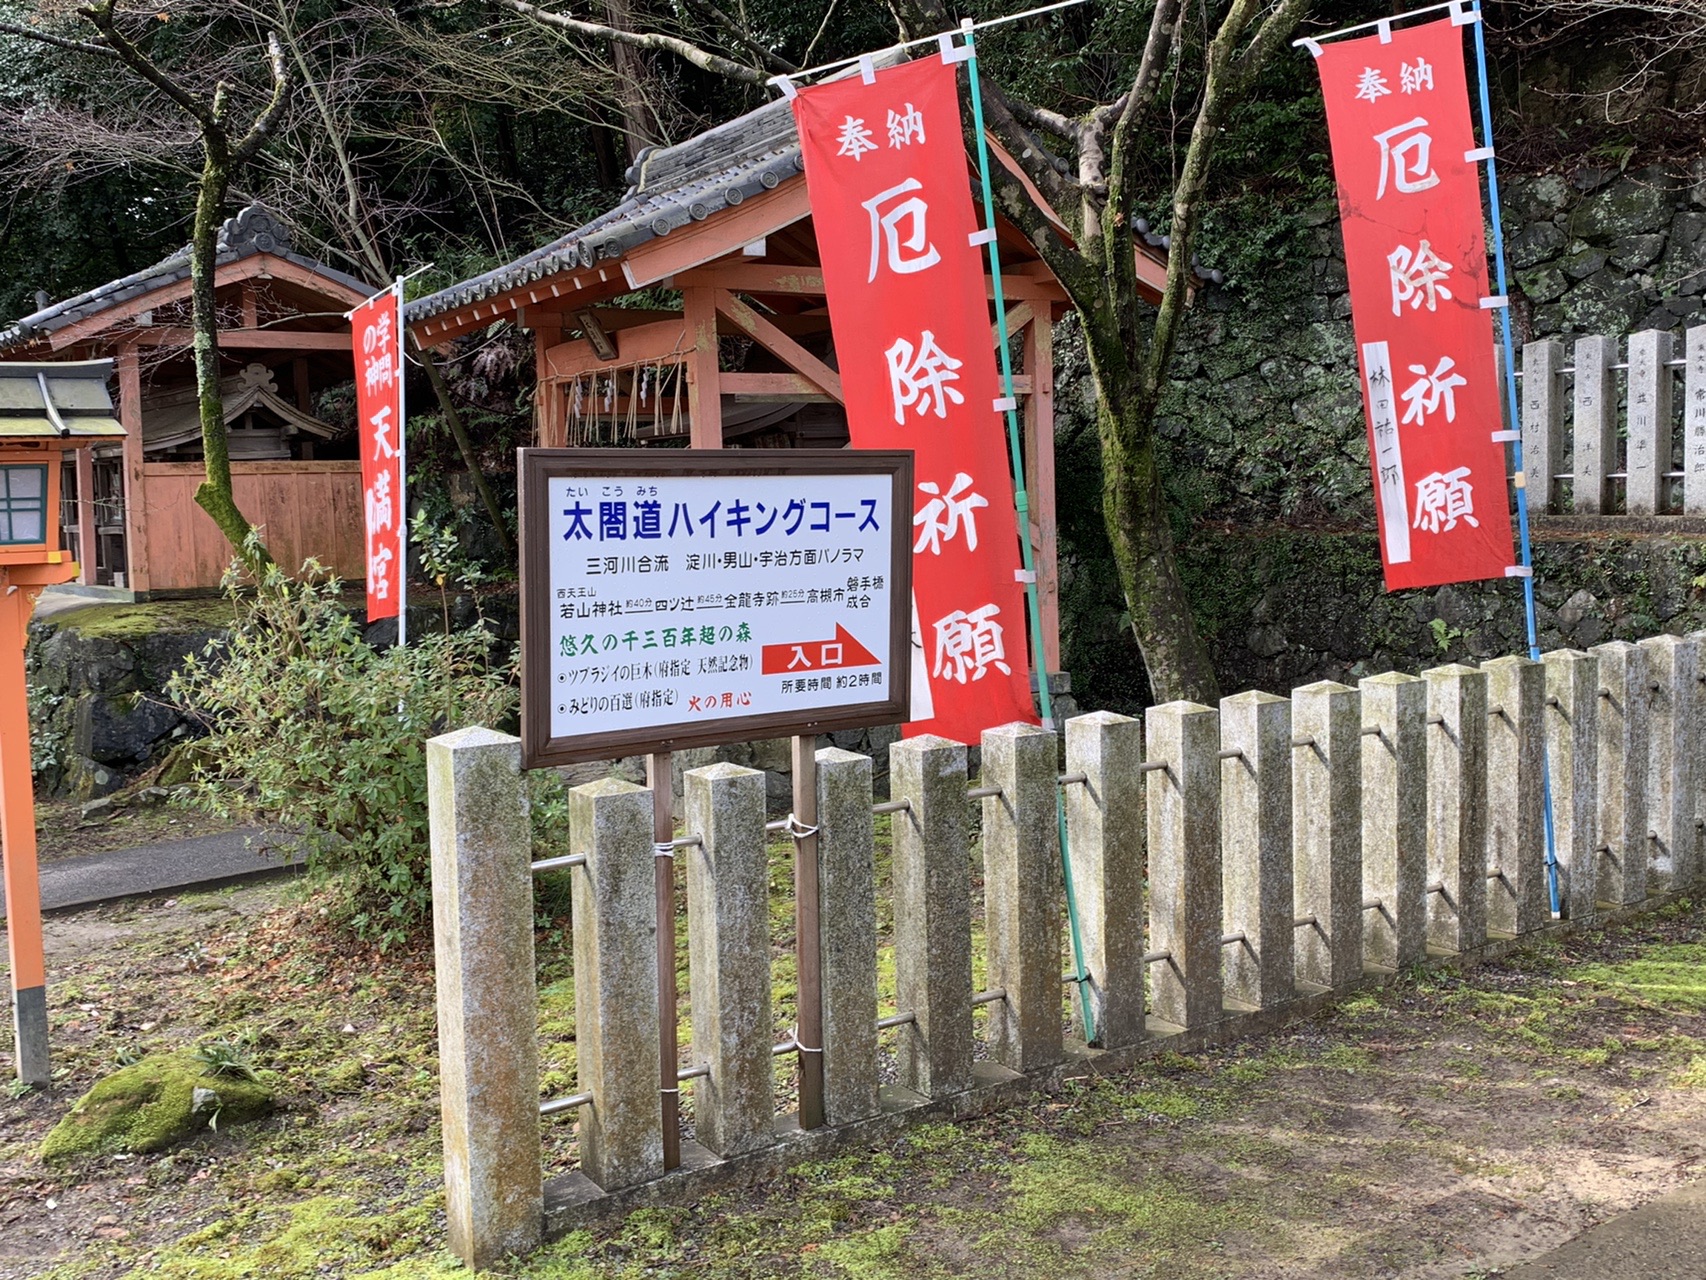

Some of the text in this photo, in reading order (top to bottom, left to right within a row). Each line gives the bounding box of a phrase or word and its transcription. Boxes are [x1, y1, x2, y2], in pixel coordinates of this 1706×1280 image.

[1355, 56, 1436, 103] 奉納
[835, 102, 928, 162] 奉納
[1373, 117, 1481, 535] 厄除祈願
[363, 324, 379, 398] の神
[376, 310, 393, 390] 学問
[860, 176, 1013, 686] 厄除祈願
[366, 405, 394, 600] 天満宮
[566, 486, 659, 497] たい こう みち
[563, 499, 880, 541] 太閤道ハイキングコース
[586, 555, 670, 575] 三河川合流
[556, 587, 597, 599] 西天王山
[846, 575, 884, 592] 磐手橋
[560, 588, 845, 619] 若山神社 約40分 四ツ辻 約45分 金龍寺跡 約25分 高槻市
[846, 594, 871, 609] 成合
[559, 621, 753, 657] 悠久の千三百年超の森
[787, 643, 843, 670] 入口
[781, 671, 883, 694] 所要時間 約2時間
[688, 691, 752, 713] 火の用心
